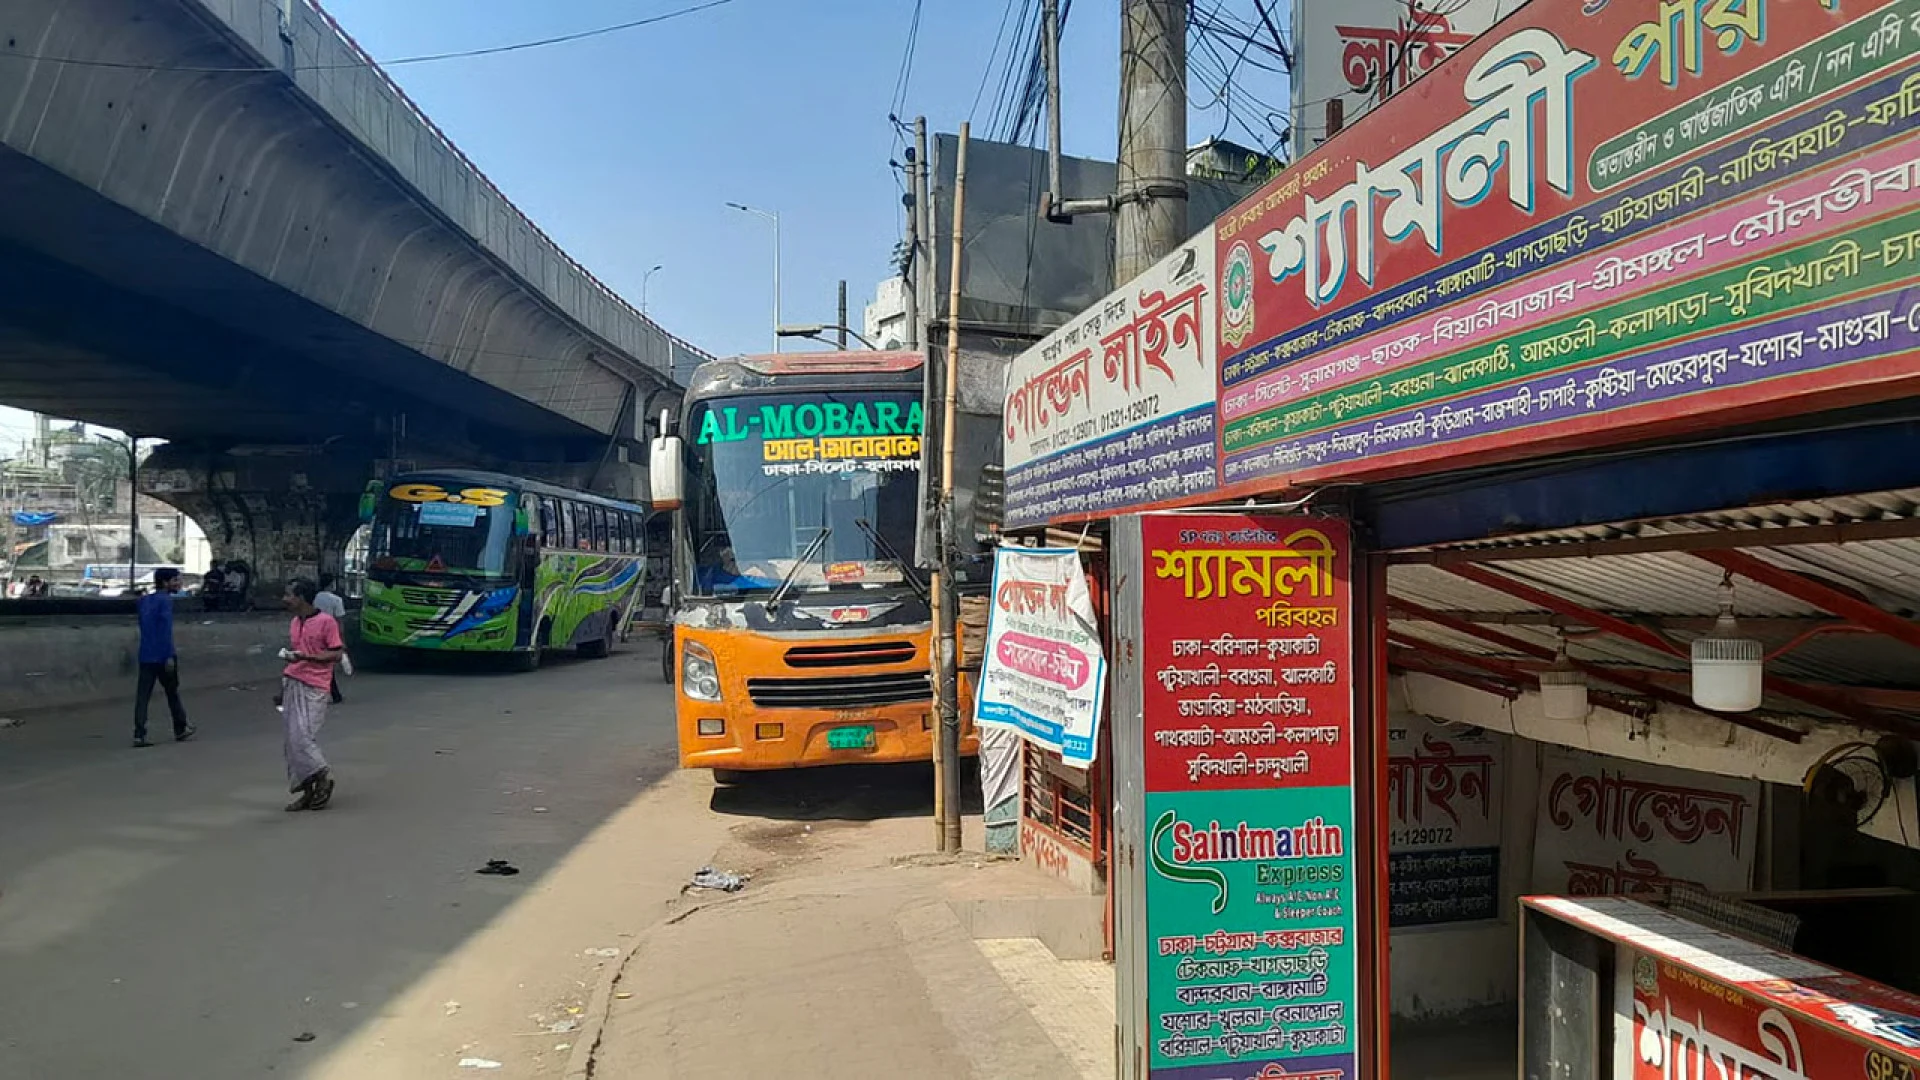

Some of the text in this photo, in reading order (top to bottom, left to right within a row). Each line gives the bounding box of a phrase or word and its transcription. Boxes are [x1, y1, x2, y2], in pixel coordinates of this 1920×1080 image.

[1663, 127, 1676, 150] ও
[1769, 59, 1806, 104] এসি
[1826, 41, 1855, 79] নন
[1861, 12, 1903, 59] এসি
[1258, 27, 1598, 307] শ্যামলী
[1006, 347, 1094, 444] গোল্ডেন
[1099, 282, 1209, 397] লাইন
[697, 400, 922, 444] AL-MOBARA
[763, 436, 925, 462] আল-মোবারাক
[1151, 528, 1336, 600] শ্যামলী
[1255, 601, 1339, 628] পরিবহন
[1280, 660, 1337, 684] ঝালকাঠি
[1547, 767, 1752, 861] গোল্ডেন
[1172, 815, 1343, 864] Saintmartin
[1255, 863, 1343, 886] Express
